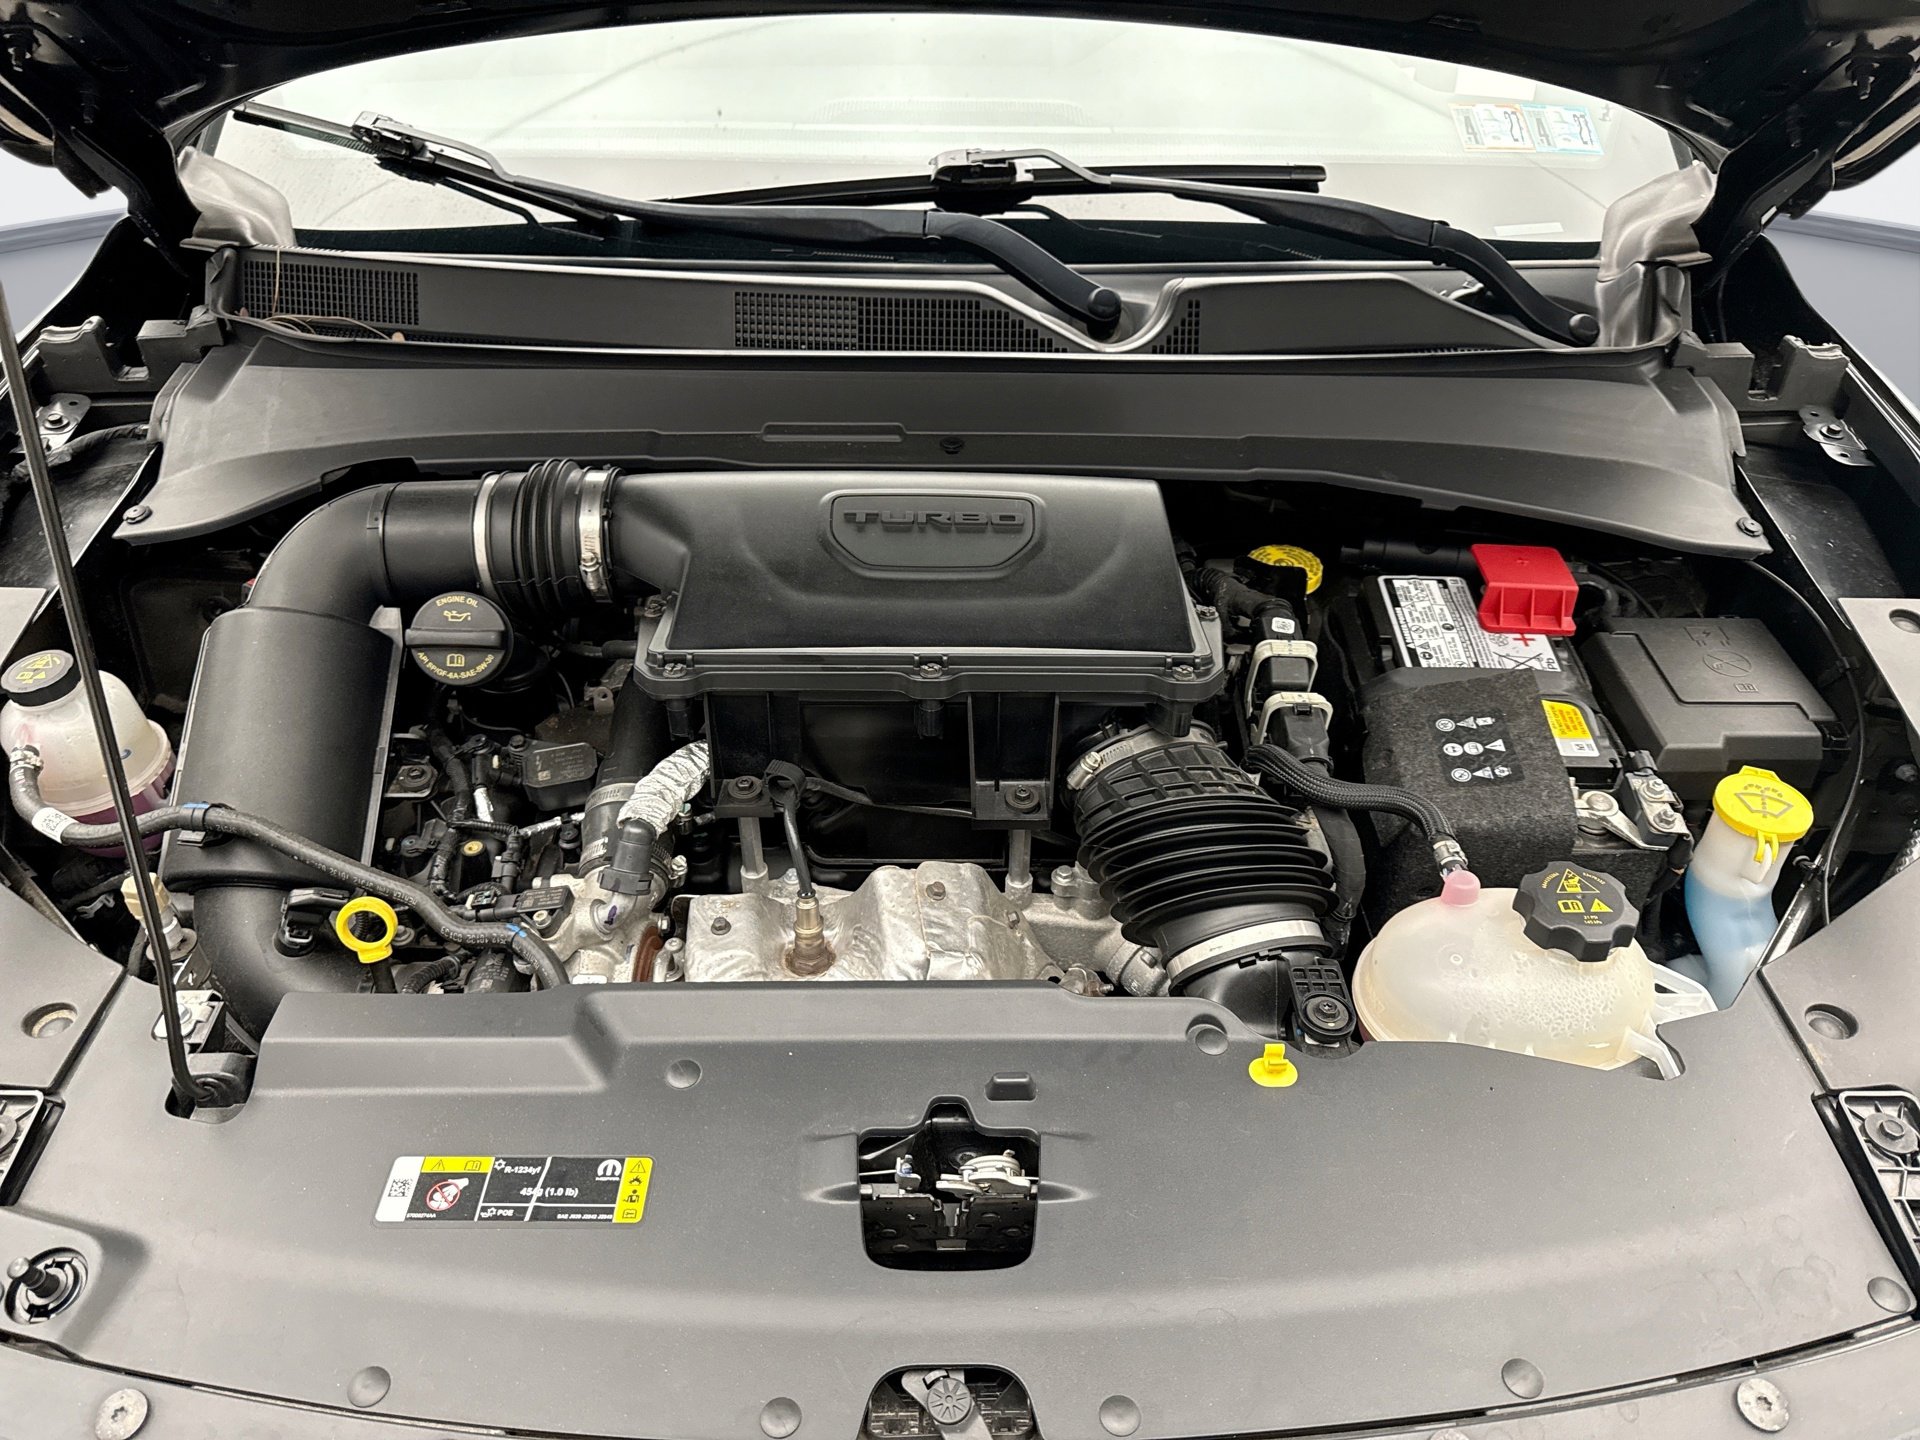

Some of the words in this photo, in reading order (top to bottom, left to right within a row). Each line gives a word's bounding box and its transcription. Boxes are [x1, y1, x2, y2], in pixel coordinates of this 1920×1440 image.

[843, 511, 1024, 532] TURBO
[435, 595, 466, 607] ENGINE
[466, 596, 479, 608] OIL
[417, 652, 429, 664] API
[504, 1166, 542, 1175] R-1234yf
[497, 1209, 514, 1217] POE
